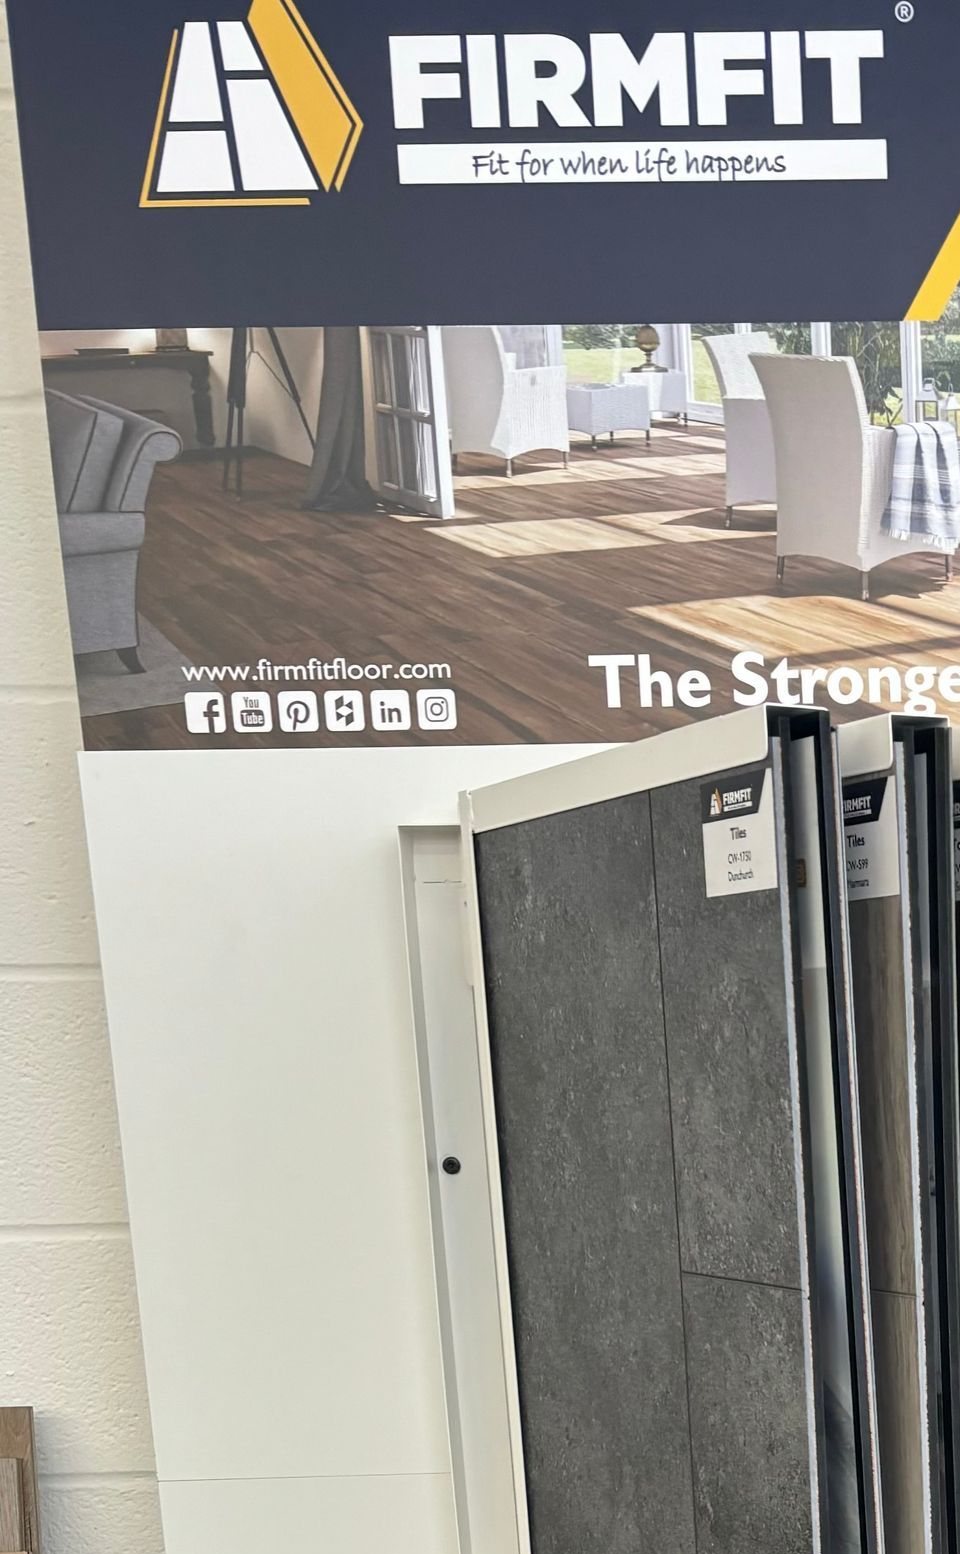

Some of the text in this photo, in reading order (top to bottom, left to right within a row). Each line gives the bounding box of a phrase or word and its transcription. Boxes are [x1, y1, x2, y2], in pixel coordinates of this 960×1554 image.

[388, 30, 884, 129] FIRMFIT
[472, 148, 786, 183] Fit for when life happens
[182, 658, 451, 681] www.firmfitfloor.com
[588, 654, 711, 708] The
[243, 696, 259, 709] You
[241, 711, 264, 726] Tube
[722, 787, 752, 806] FIRMFIT
[844, 795, 872, 812] IRMFIT
[730, 827, 747, 840] Tiles
[847, 834, 865, 848] Tiles
